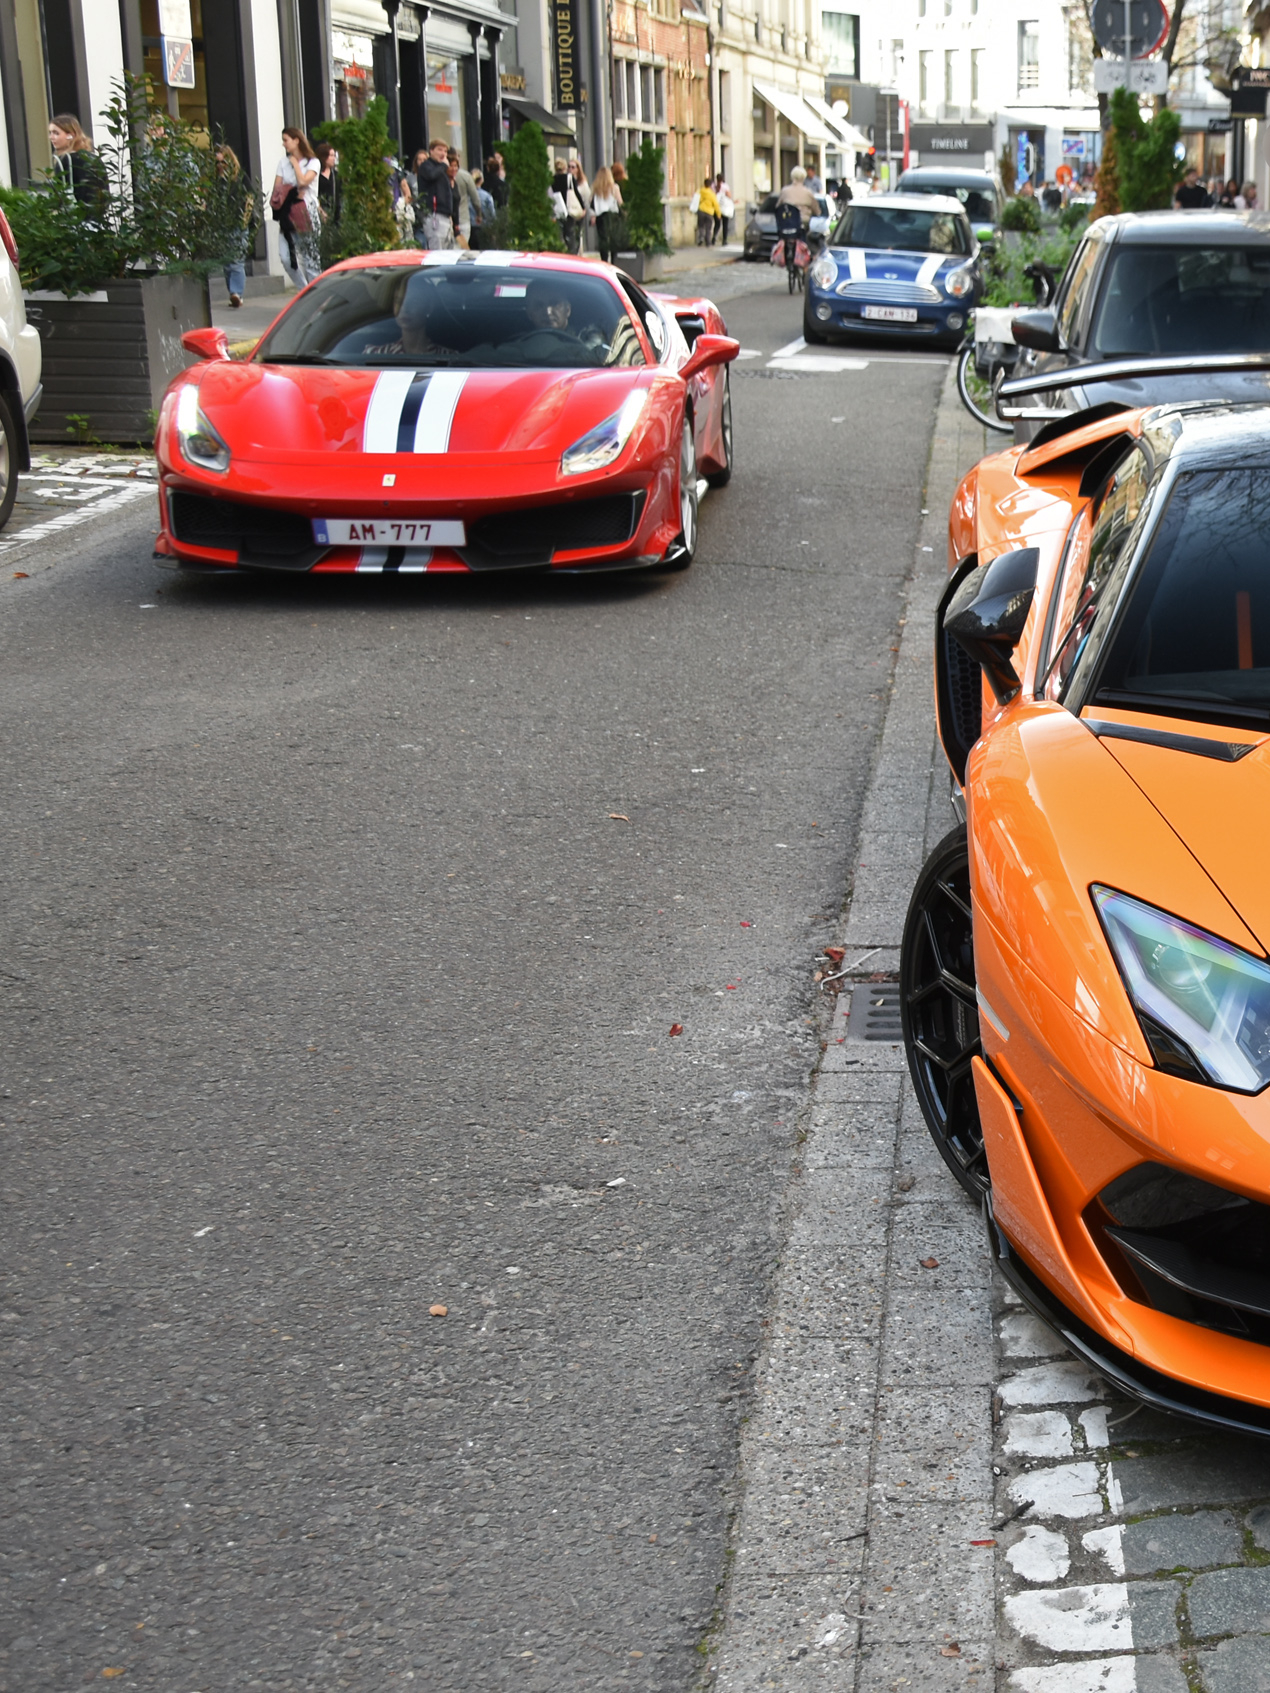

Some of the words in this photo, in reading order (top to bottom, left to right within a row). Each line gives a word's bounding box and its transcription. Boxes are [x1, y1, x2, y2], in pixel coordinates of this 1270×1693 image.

[557, 9, 574, 104] BOUTIQUE
[931, 138, 968, 150] TIMELINE
[317, 533, 327, 543] B
[349, 523, 432, 541] AM-777
